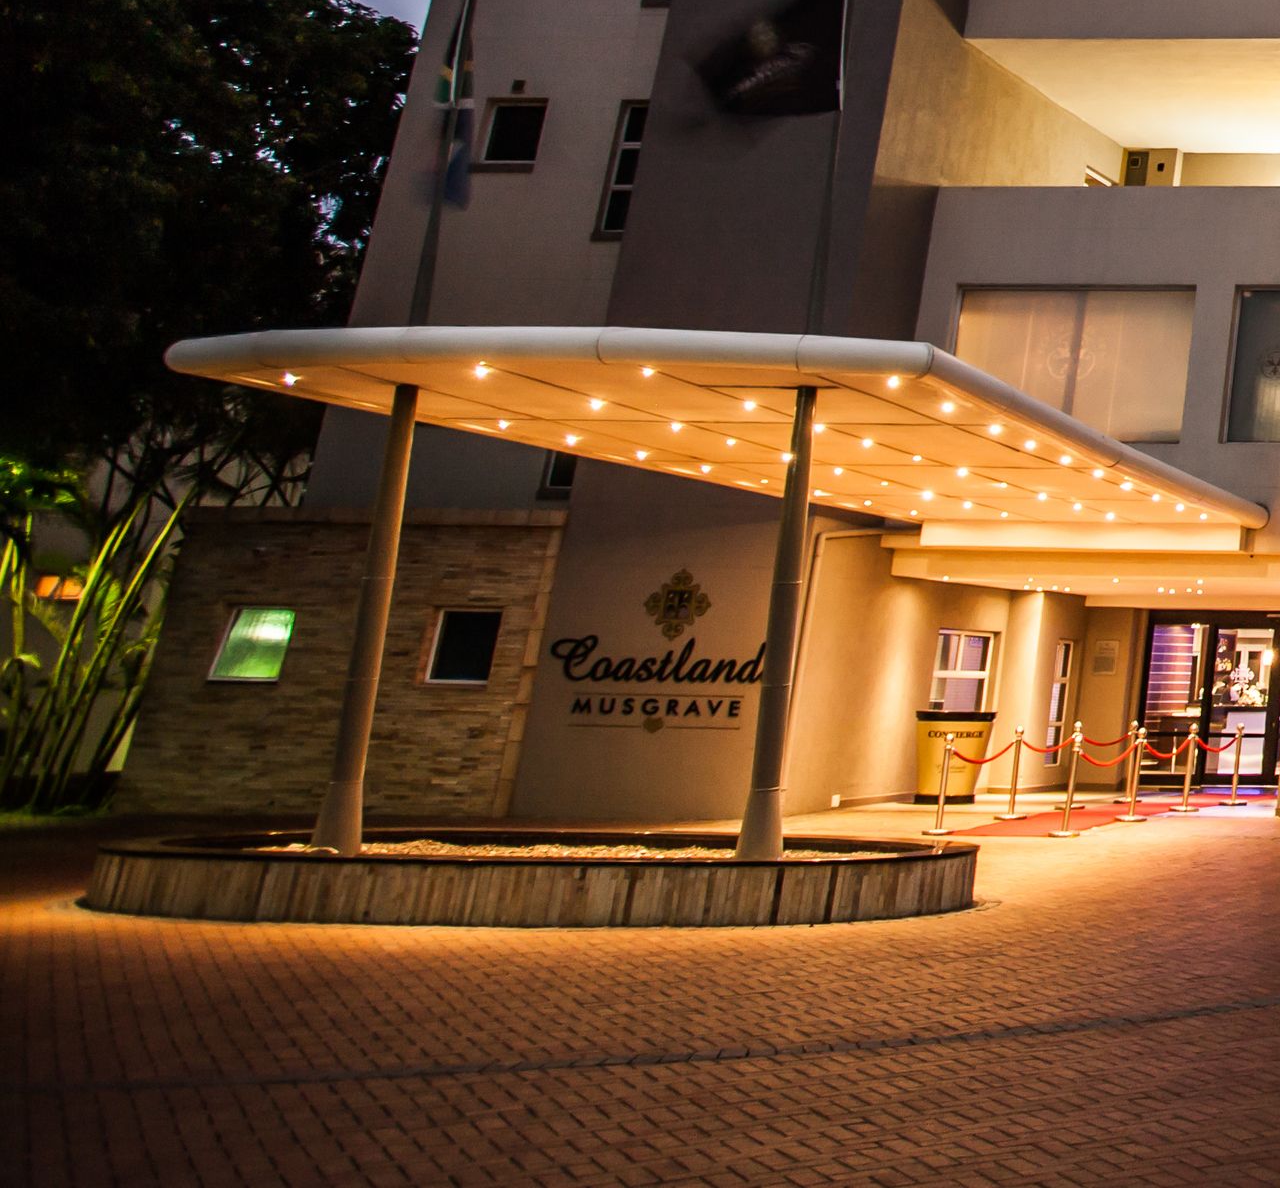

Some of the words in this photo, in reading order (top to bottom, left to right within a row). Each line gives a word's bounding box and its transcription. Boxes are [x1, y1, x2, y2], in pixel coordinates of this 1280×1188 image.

[550, 635, 766, 684] Coastland
[571, 697, 742, 717] MUSGRAVE
[927, 730, 984, 739] CONIERGE
